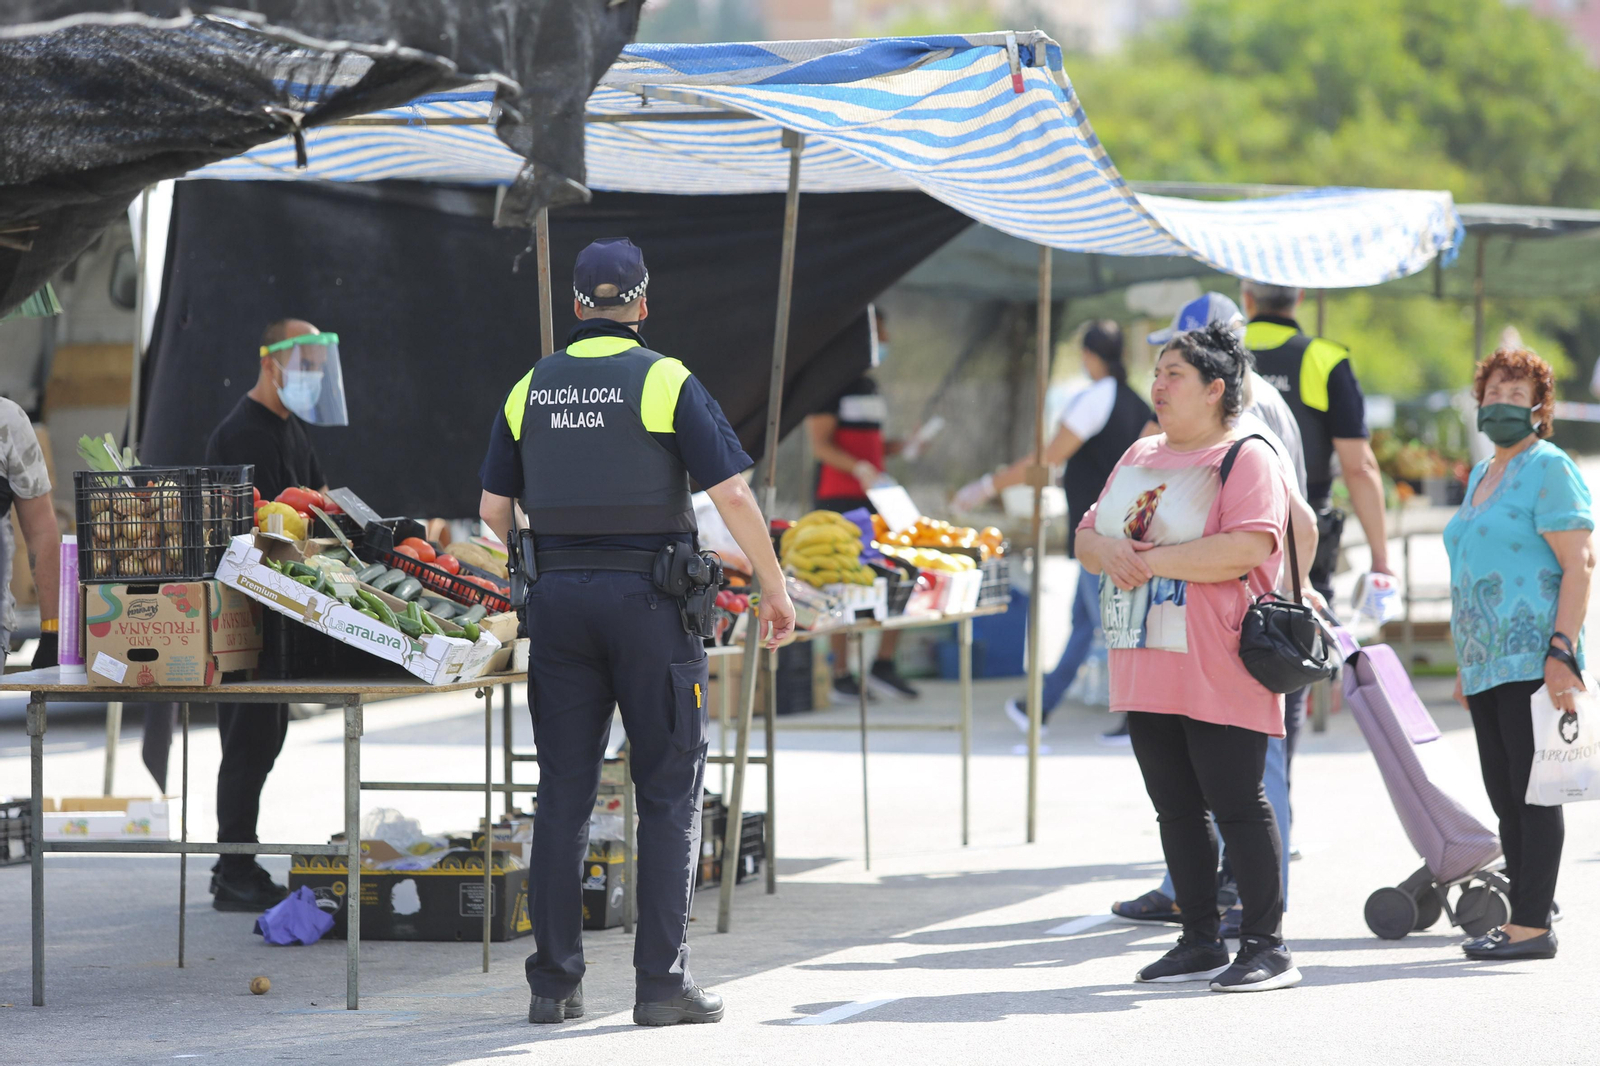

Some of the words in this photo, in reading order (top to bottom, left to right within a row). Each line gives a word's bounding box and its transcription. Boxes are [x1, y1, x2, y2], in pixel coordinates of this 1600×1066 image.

[529, 385, 579, 406] POLICÍA
[582, 387, 624, 404] LOCAL
[550, 408, 605, 429] MÁLAGA
[240, 576, 278, 600] Premium
[125, 636, 153, 646] AND.
